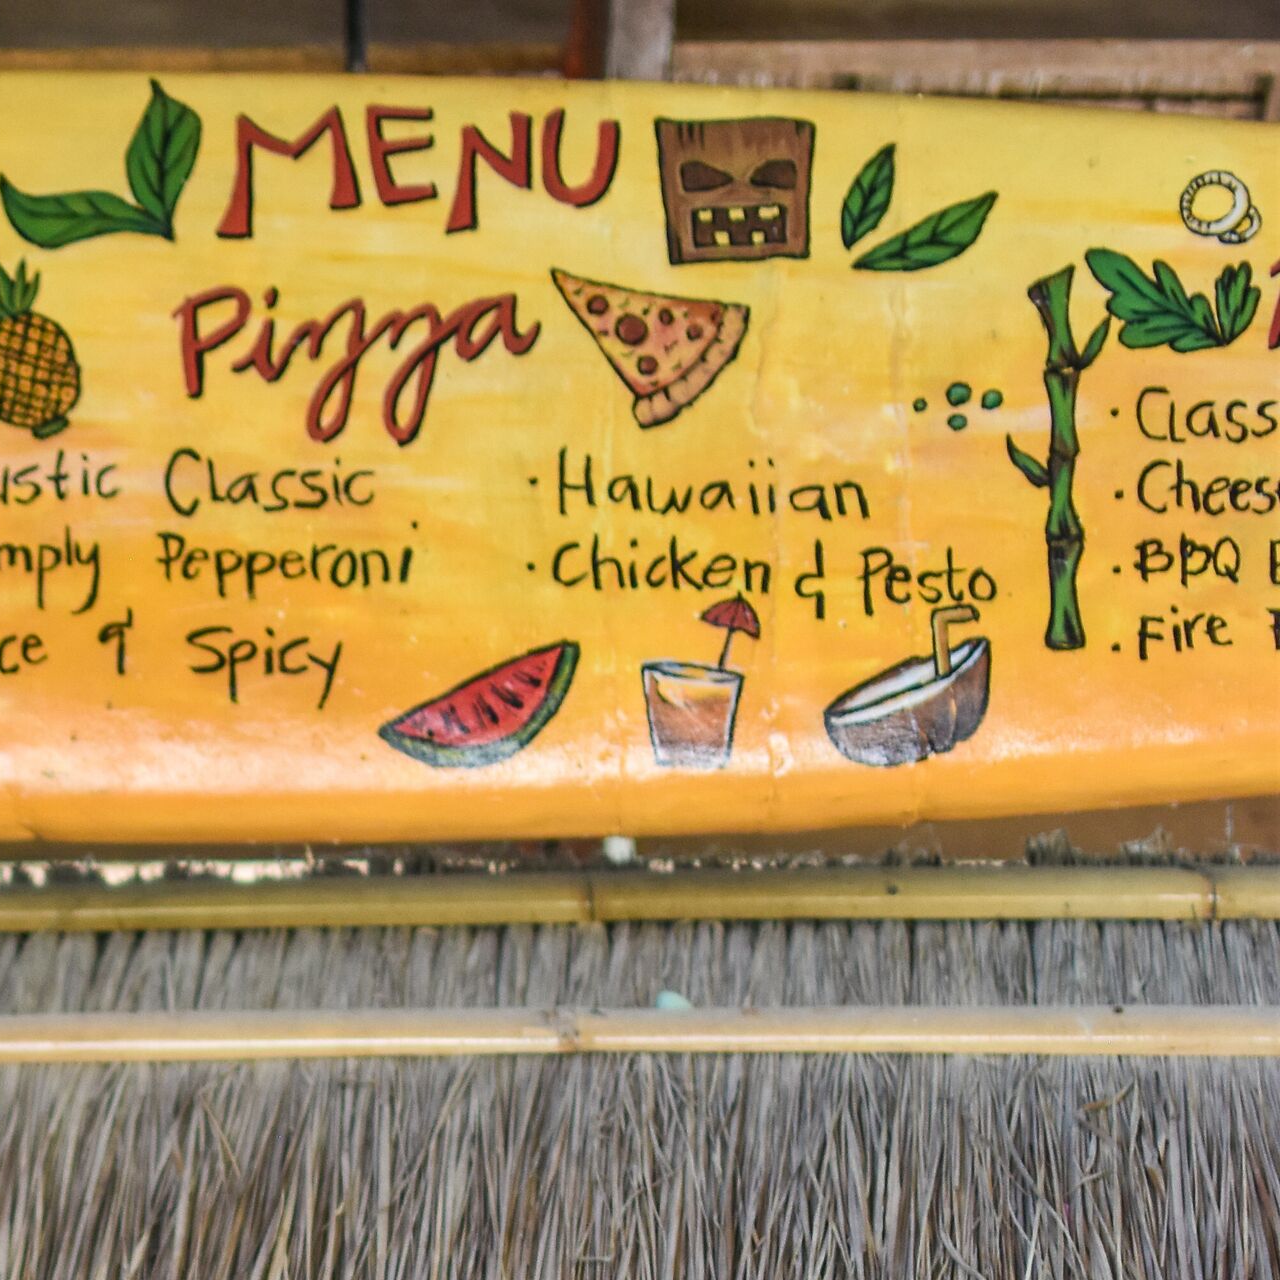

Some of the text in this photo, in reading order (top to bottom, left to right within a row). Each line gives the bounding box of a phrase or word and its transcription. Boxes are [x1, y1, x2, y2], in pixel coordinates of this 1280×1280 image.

[217, 104, 621, 239] MENU
[172, 285, 542, 447] Pizza
[163, 448, 377, 518] Classic
[555, 445, 871, 521] Hawaiian
[1136, 457, 1280, 517] Chees
[155, 520, 420, 599] Pepperoni
[551, 532, 773, 597] Chicken
[859, 545, 999, 617] Pesto
[1132, 531, 1242, 589] BBQ
[184, 625, 345, 710] Spicy
[1137, 603, 1235, 661] Fire
